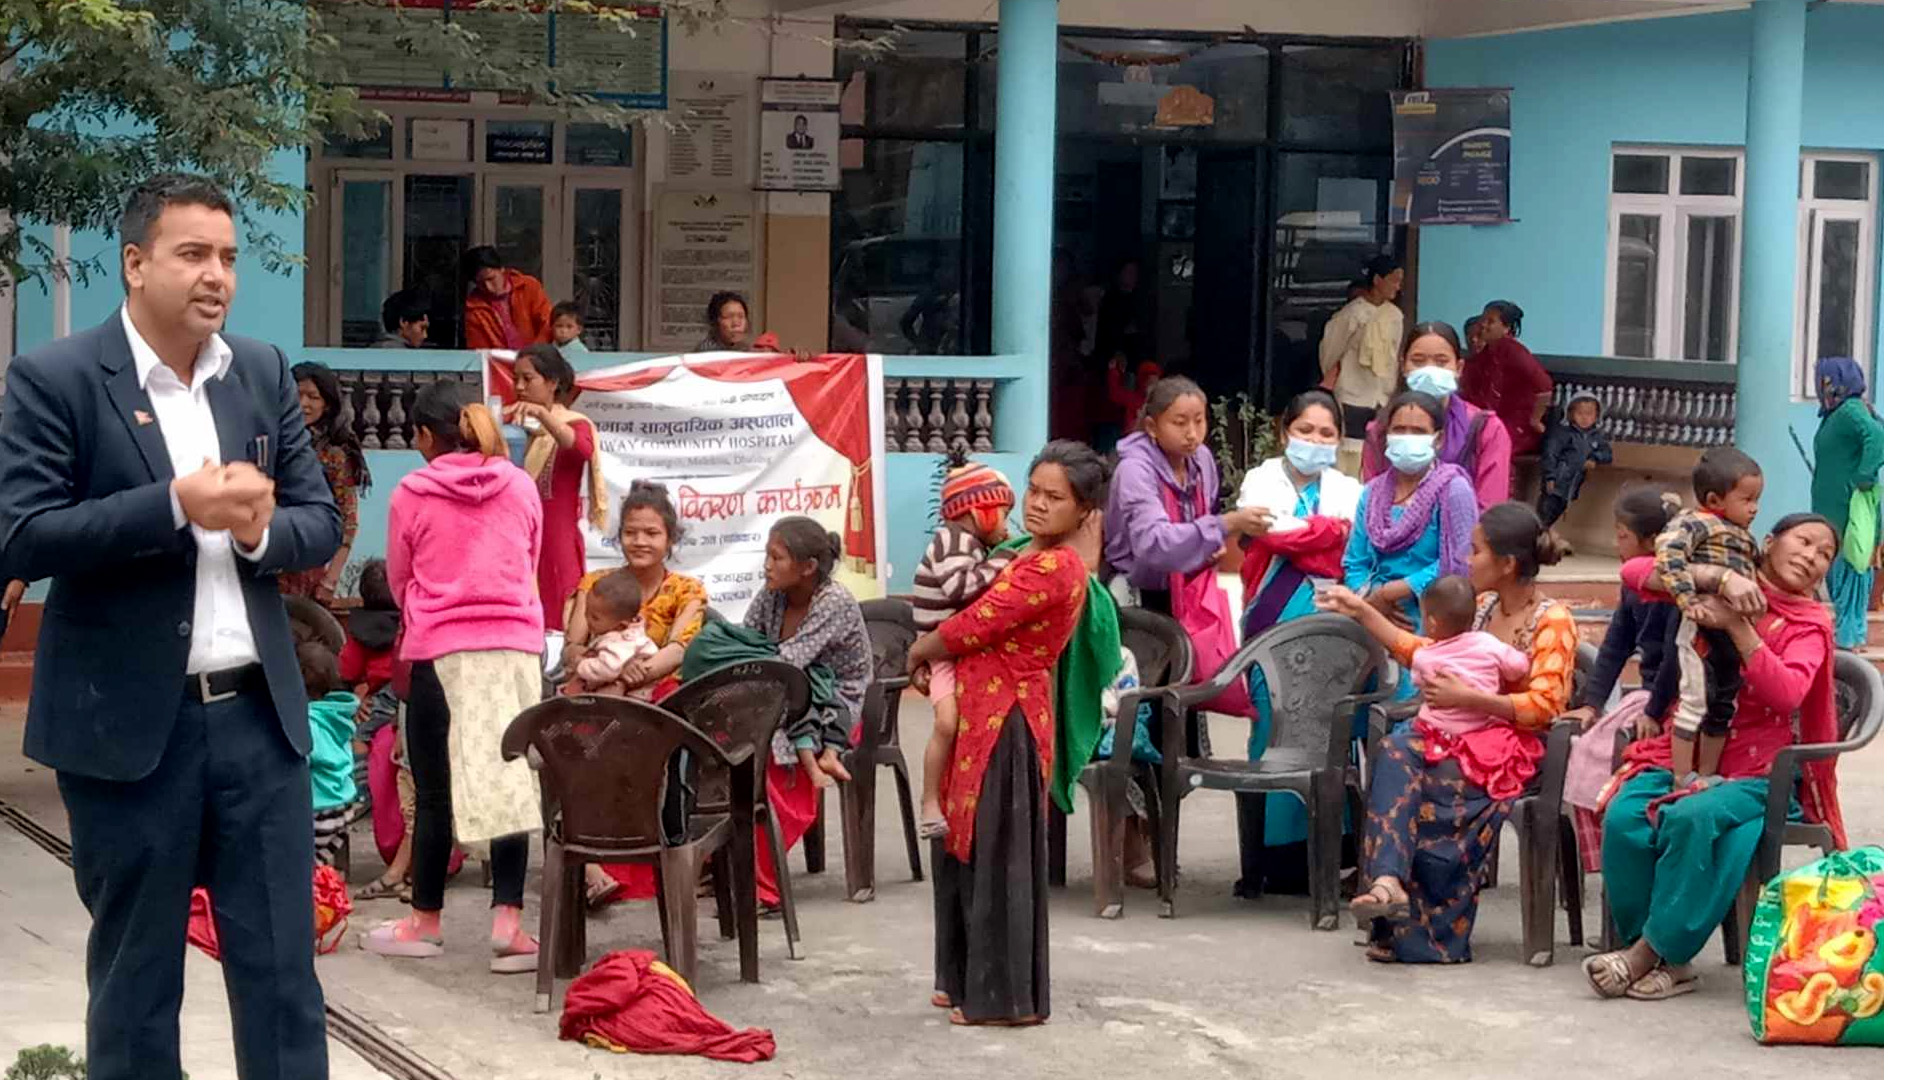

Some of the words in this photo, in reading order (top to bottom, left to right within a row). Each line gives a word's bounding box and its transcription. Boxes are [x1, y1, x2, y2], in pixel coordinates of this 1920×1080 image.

[639, 416, 723, 437] सामुदायिक
[729, 413, 794, 430] अस्पताल
[729, 433, 795, 449] HOSPITAL
[678, 485, 746, 521] वितरण
[756, 478, 842, 515] कार्यक्रम
